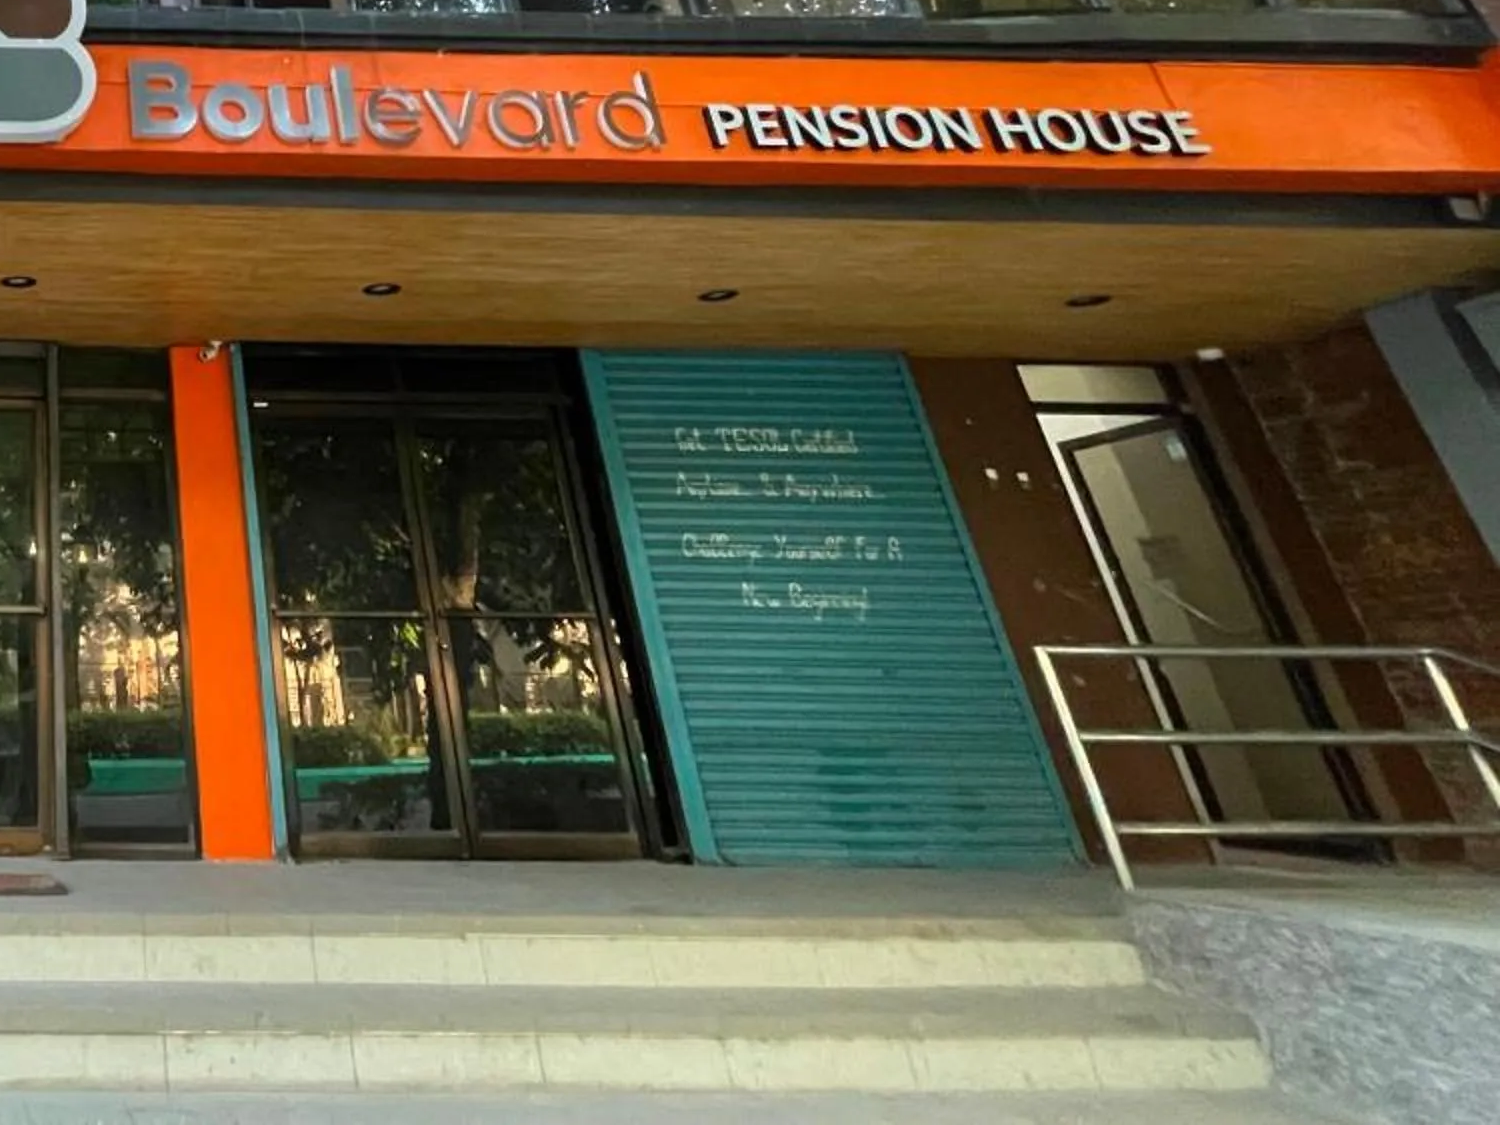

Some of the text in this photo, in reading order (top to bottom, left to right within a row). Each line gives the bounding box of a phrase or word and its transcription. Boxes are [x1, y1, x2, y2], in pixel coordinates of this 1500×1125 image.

[127, 60, 1211, 156] Boulevard PENSION HOUSE
